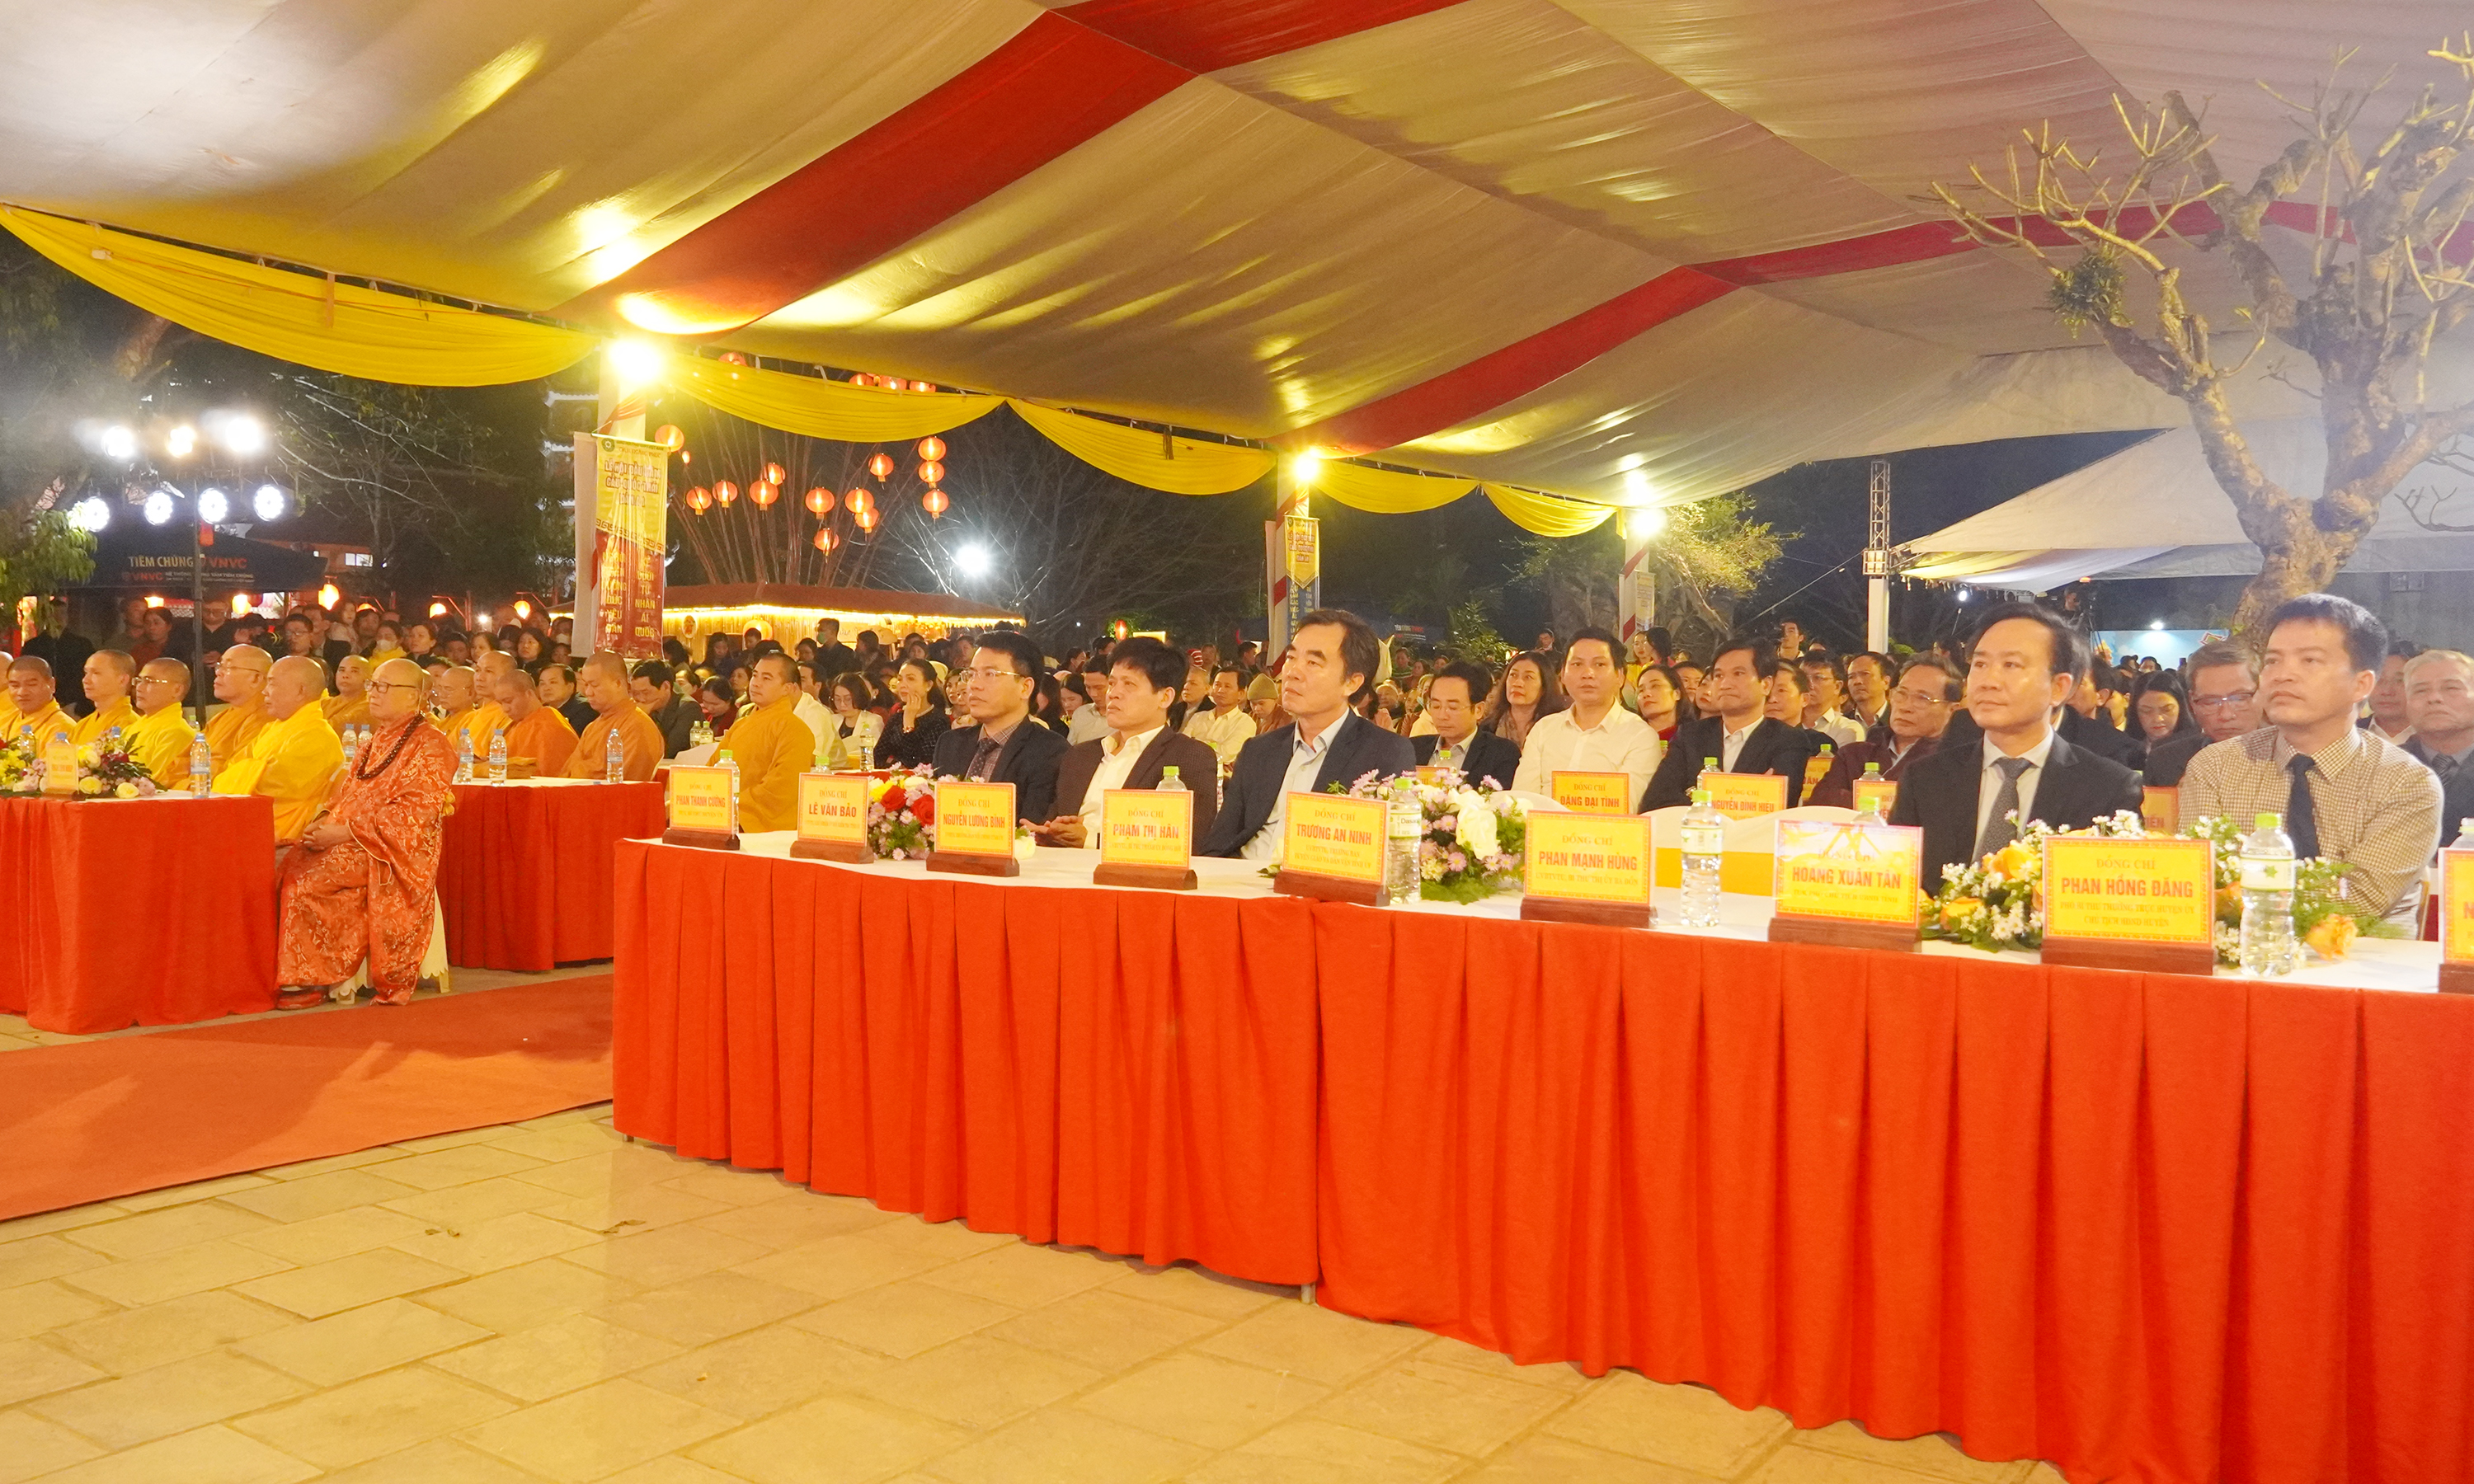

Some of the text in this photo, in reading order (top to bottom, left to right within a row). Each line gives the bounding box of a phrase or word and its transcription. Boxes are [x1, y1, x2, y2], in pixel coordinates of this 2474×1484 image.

[129, 554, 247, 569] TIÊM CHỦNG VNVC
[635, 599, 656, 609] NHÂN
[634, 625, 655, 637] QUỐC
[819, 787, 847, 799] ĐỒNG CHÍ
[1573, 781, 1606, 791] ĐỒNG CHÍ
[1725, 787, 1744, 796] ĐỒNG
[676, 795, 689, 805] PHAN
[690, 795, 708, 806] THANH
[958, 795, 990, 808] ĐỒNG CHÍ
[1560, 794, 1583, 808] ĐẶNG
[1584, 796, 1598, 809] ĐẠI
[1711, 796, 1738, 810] NGUYỄN
[1740, 799, 1757, 811] ĐÌNH
[809, 801, 857, 818] LÊ VĂN BẢO
[1127, 806, 1164, 818] ĐỒNG CHÍ
[1315, 808, 1356, 821] ĐỒNG CHÍ
[943, 810, 967, 826] NGUYỄN
[968, 814, 989, 828] LƯƠNG
[1112, 823, 1179, 841] PHẠM THỊ HÂN
[1296, 823, 1372, 846] TRƯƠNG AN NINH
[1562, 832, 1613, 846] ĐỒNG CHÍ
[1350, 849, 1360, 857] BAN
[1539, 851, 1637, 871] PHAN MẠNH HÙNG
[2096, 855, 2156, 870] ĐỒNG CHÍ
[1577, 874, 1589, 882] THƯ
[1614, 876, 1623, 885] BA
[1792, 865, 1901, 889] HOÀNG XUÂN TÂN
[2062, 877, 2100, 895] PHAN
[2152, 877, 2193, 898] ĐĂNG
[2135, 904, 2155, 913] TRỰC
[2157, 904, 2182, 914] HUYỆN
[2084, 913, 2099, 923] CHỦ
[2101, 916, 2118, 926] TỊCH
[2143, 917, 2169, 927] HUYỆN
